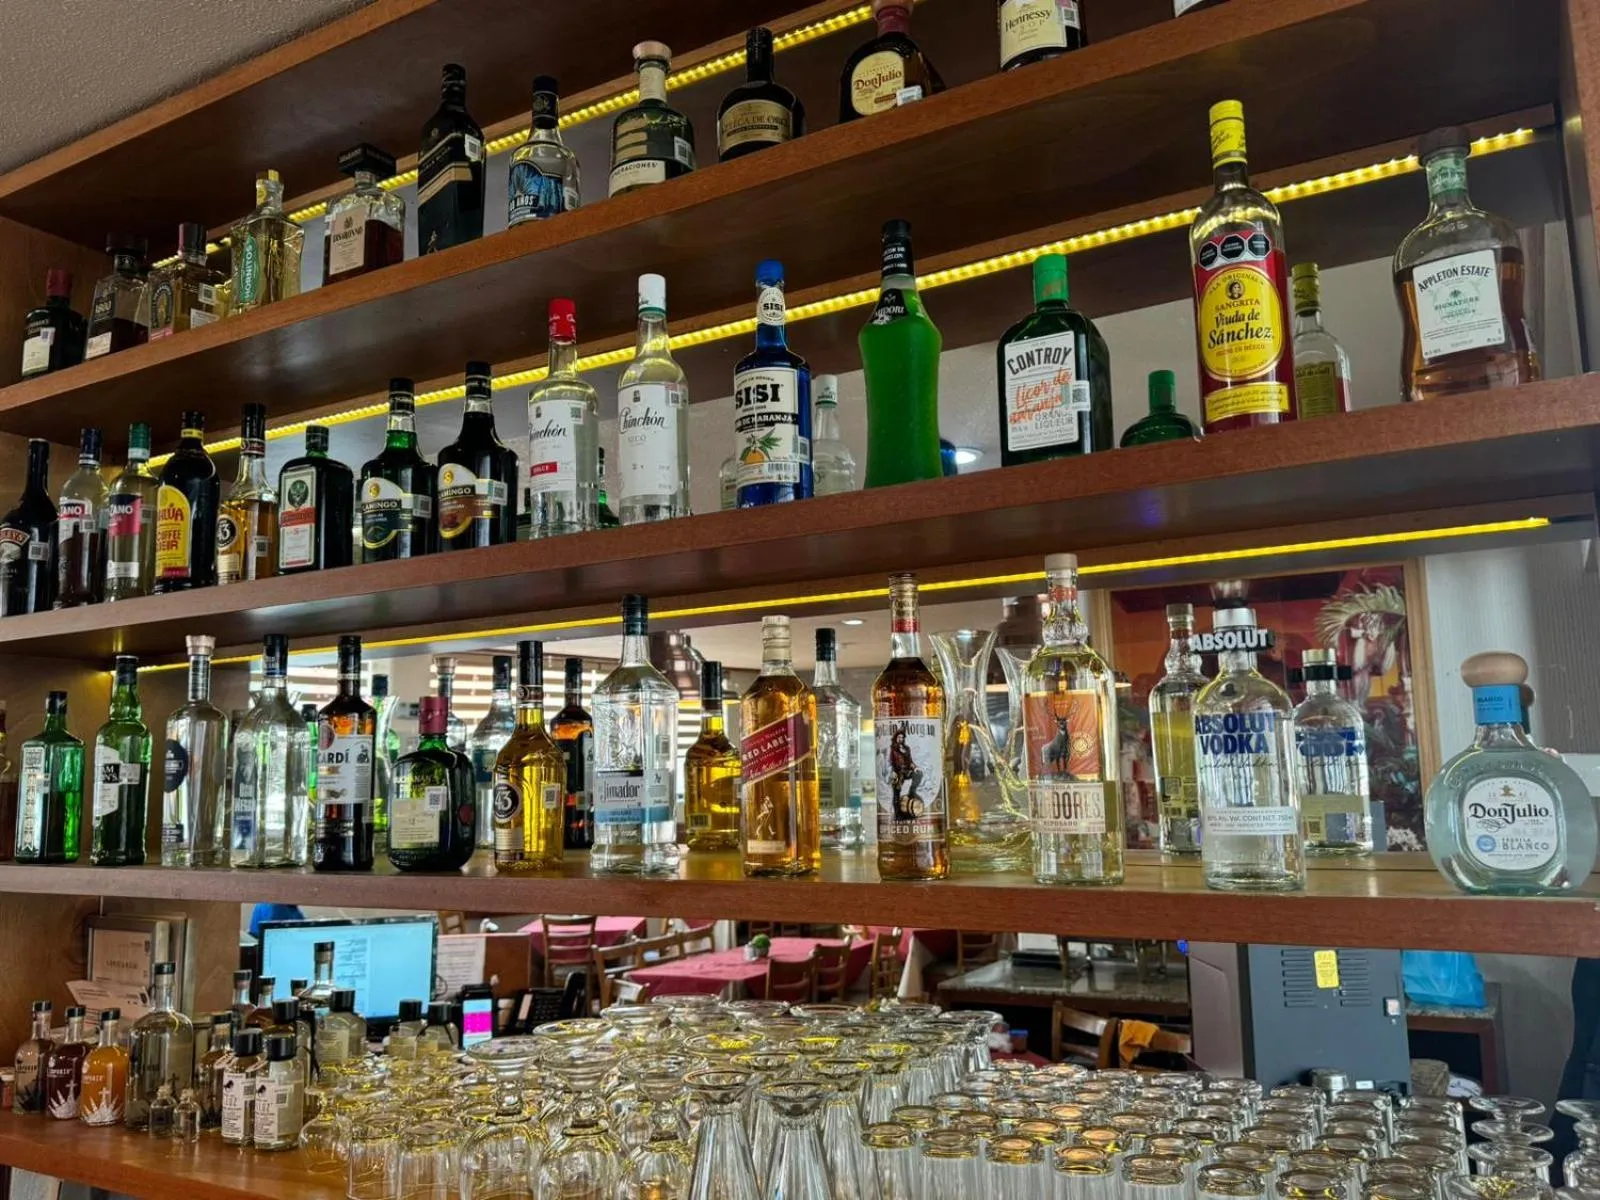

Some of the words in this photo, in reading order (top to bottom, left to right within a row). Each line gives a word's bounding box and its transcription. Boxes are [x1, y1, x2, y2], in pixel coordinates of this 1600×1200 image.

[1005, 9, 1053, 32] Hennessy
[1418, 266, 1459, 292] APPLETON
[1461, 264, 1490, 278] ESTATE
[763, 302, 783, 312] SISI
[1215, 299, 1260, 311] SANGRITA
[1215, 310, 1245, 328] Viuda
[1247, 308, 1260, 321] de
[1208, 322, 1271, 349] Sánchez
[1006, 346, 1072, 376] CONTROY
[735, 384, 780, 410] SISI
[752, 413, 794, 425] NARANJA
[1190, 628, 1270, 652] ABSOLUT
[1195, 711, 1277, 735] ABSOLUT
[742, 748, 759, 762] RED
[760, 734, 792, 752] LABEL
[1200, 733, 1270, 756] VODKA
[495, 789, 513, 811] 43
[912, 824, 936, 834] RUM
[1502, 842, 1550, 851] BLANCO
